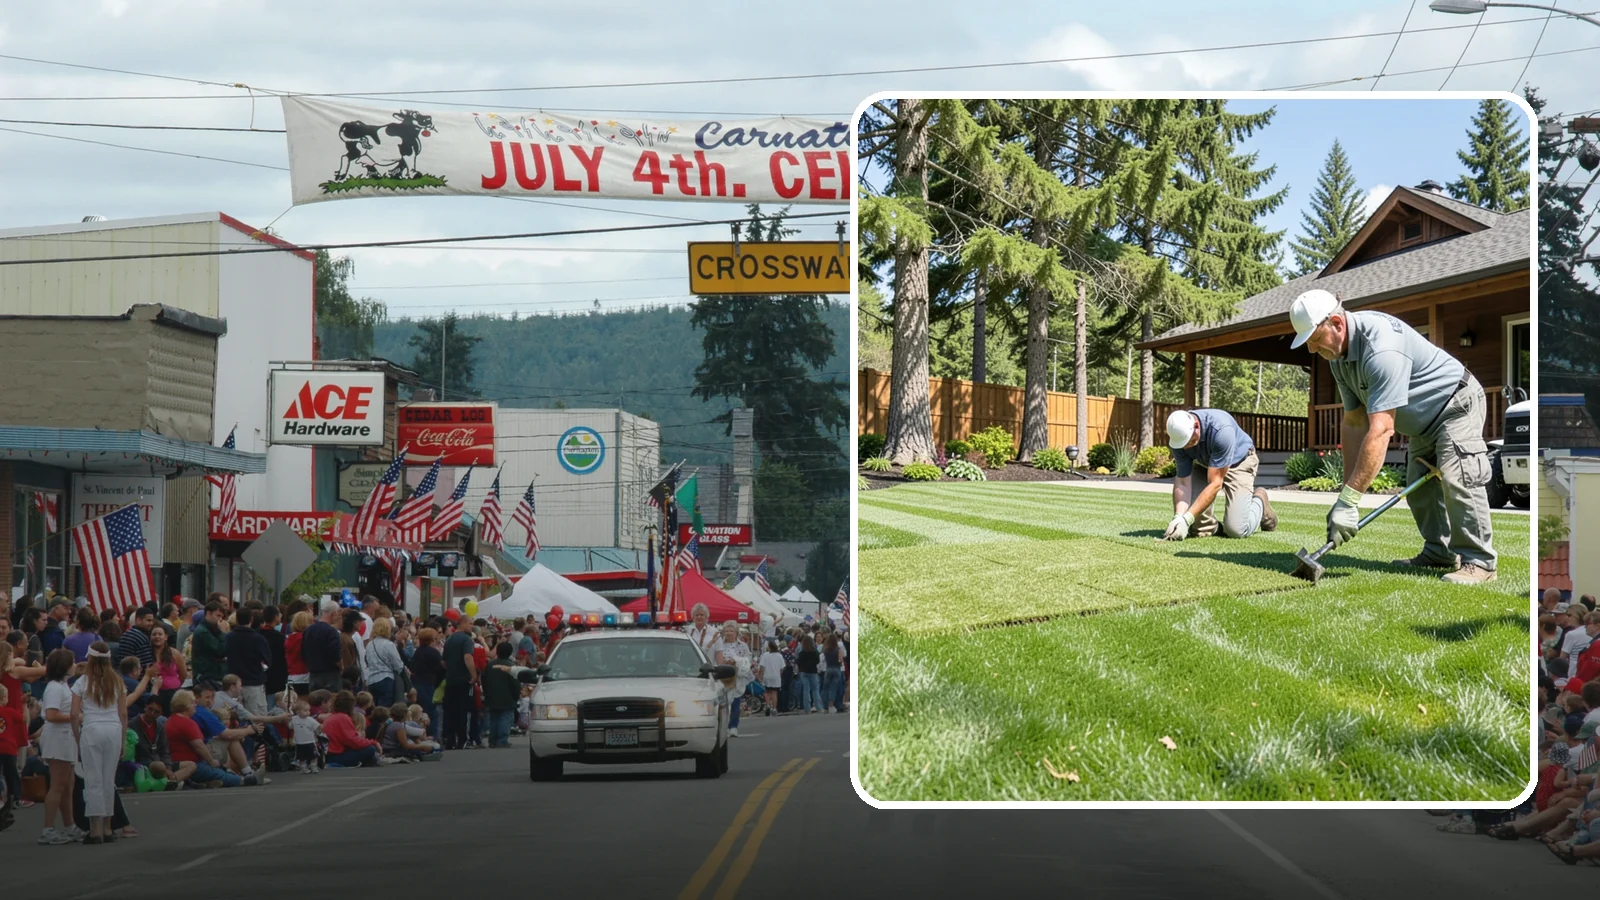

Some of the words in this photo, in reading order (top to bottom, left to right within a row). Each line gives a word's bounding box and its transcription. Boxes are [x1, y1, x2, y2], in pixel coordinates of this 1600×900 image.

[695, 121, 850, 149] Carnat
[481, 141, 605, 192] JULY
[632, 149, 747, 198] 4th.
[696, 253, 850, 280] CROSSWA
[283, 380, 374, 420] ACE
[405, 409, 453, 422] CEDAR
[283, 421, 371, 436] Hardware
[416, 428, 477, 447] Coca-Cola
[353, 467, 387, 481] Simpl
[83, 485, 94, 494] St.
[96, 485, 124, 495] Vincent
[126, 486, 136, 494] de
[138, 485, 155, 495] Paul
[688, 526, 742, 535] CRNATION
[699, 535, 731, 543] GLASS
